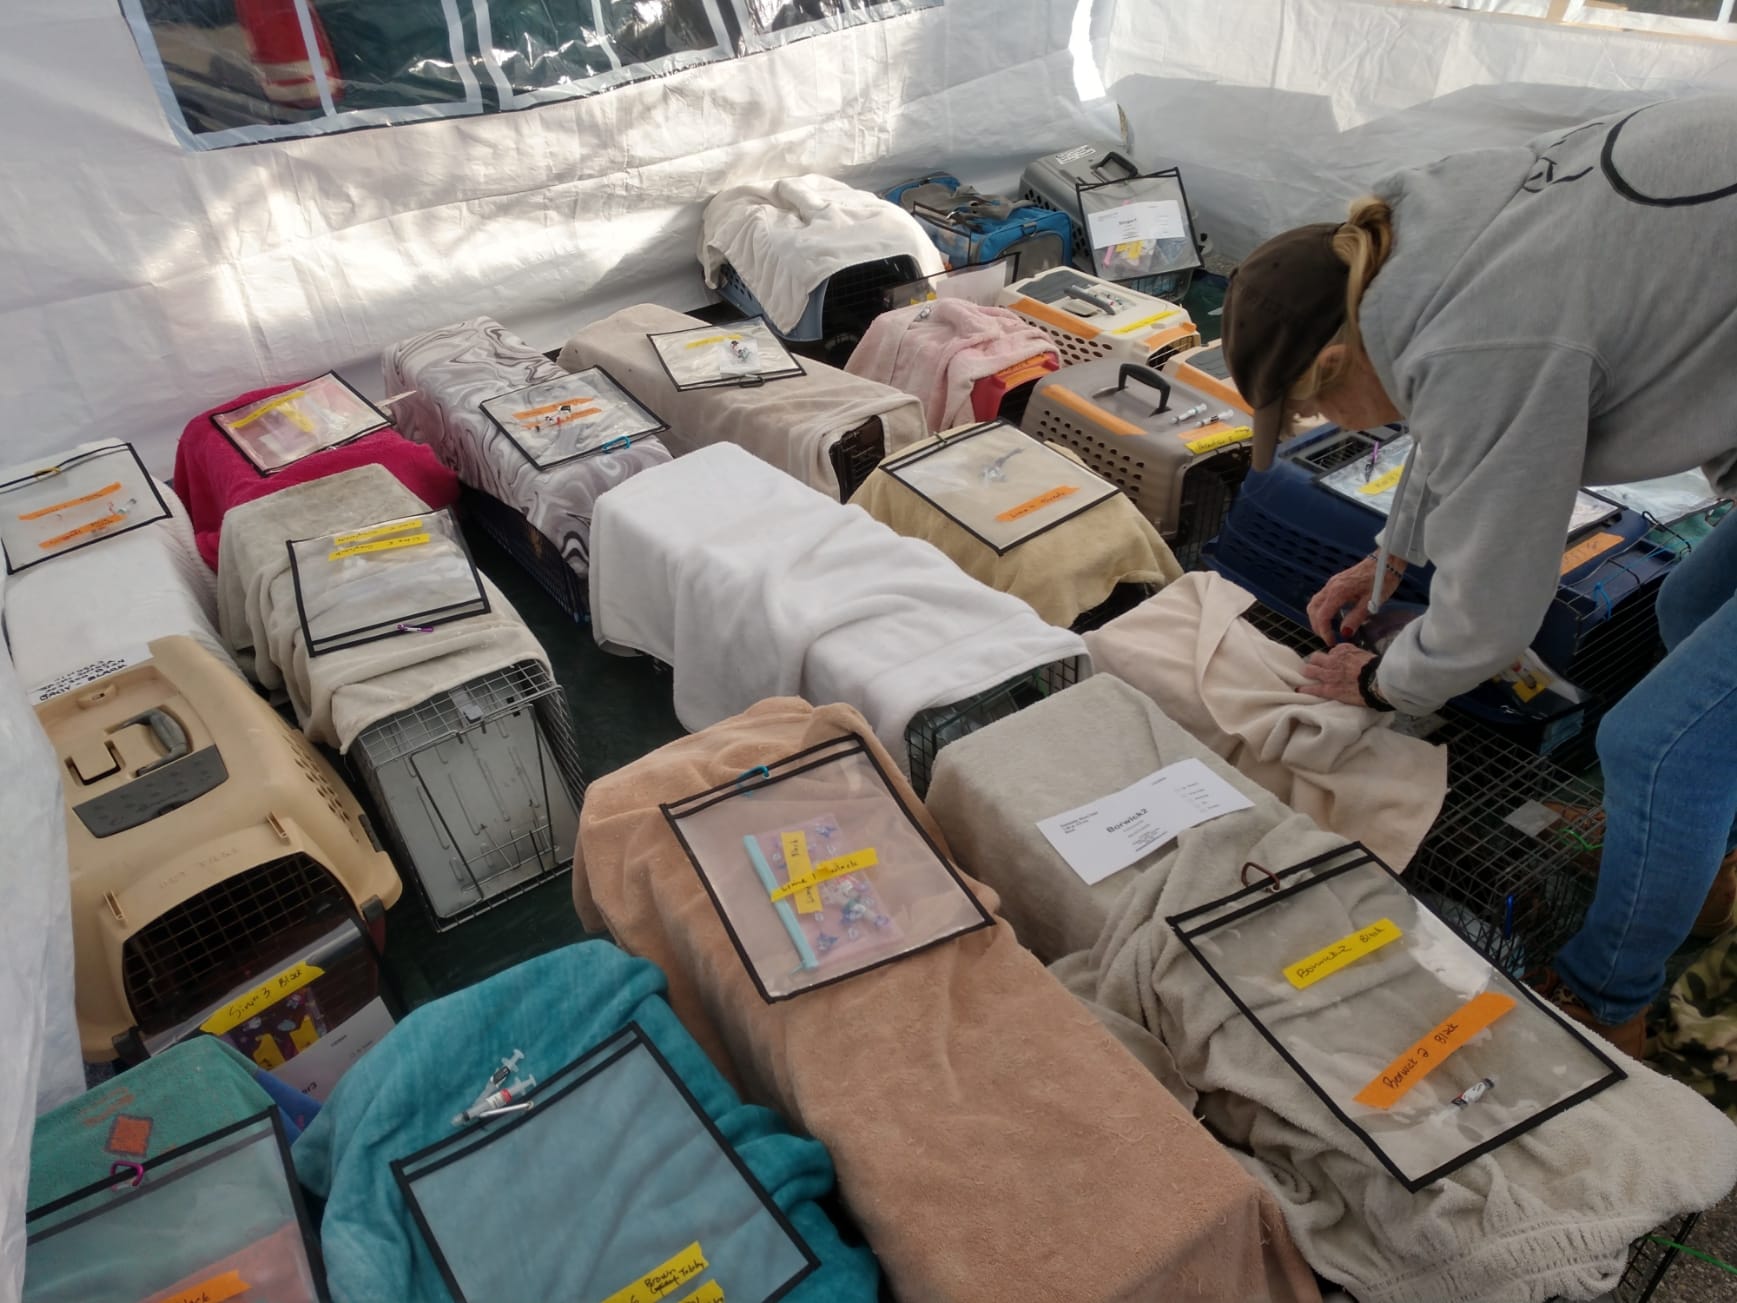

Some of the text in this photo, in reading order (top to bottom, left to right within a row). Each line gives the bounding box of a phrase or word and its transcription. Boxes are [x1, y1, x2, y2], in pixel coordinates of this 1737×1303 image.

[1359, 927, 1384, 943] Black
[261, 988, 271, 999] 3
[278, 969, 303, 988] Black
[1417, 1047, 1430, 1058] 2
[1433, 1022, 1459, 1044] Black
[644, 1269, 676, 1288] Brown
[678, 1258, 705, 1277] Tabby
